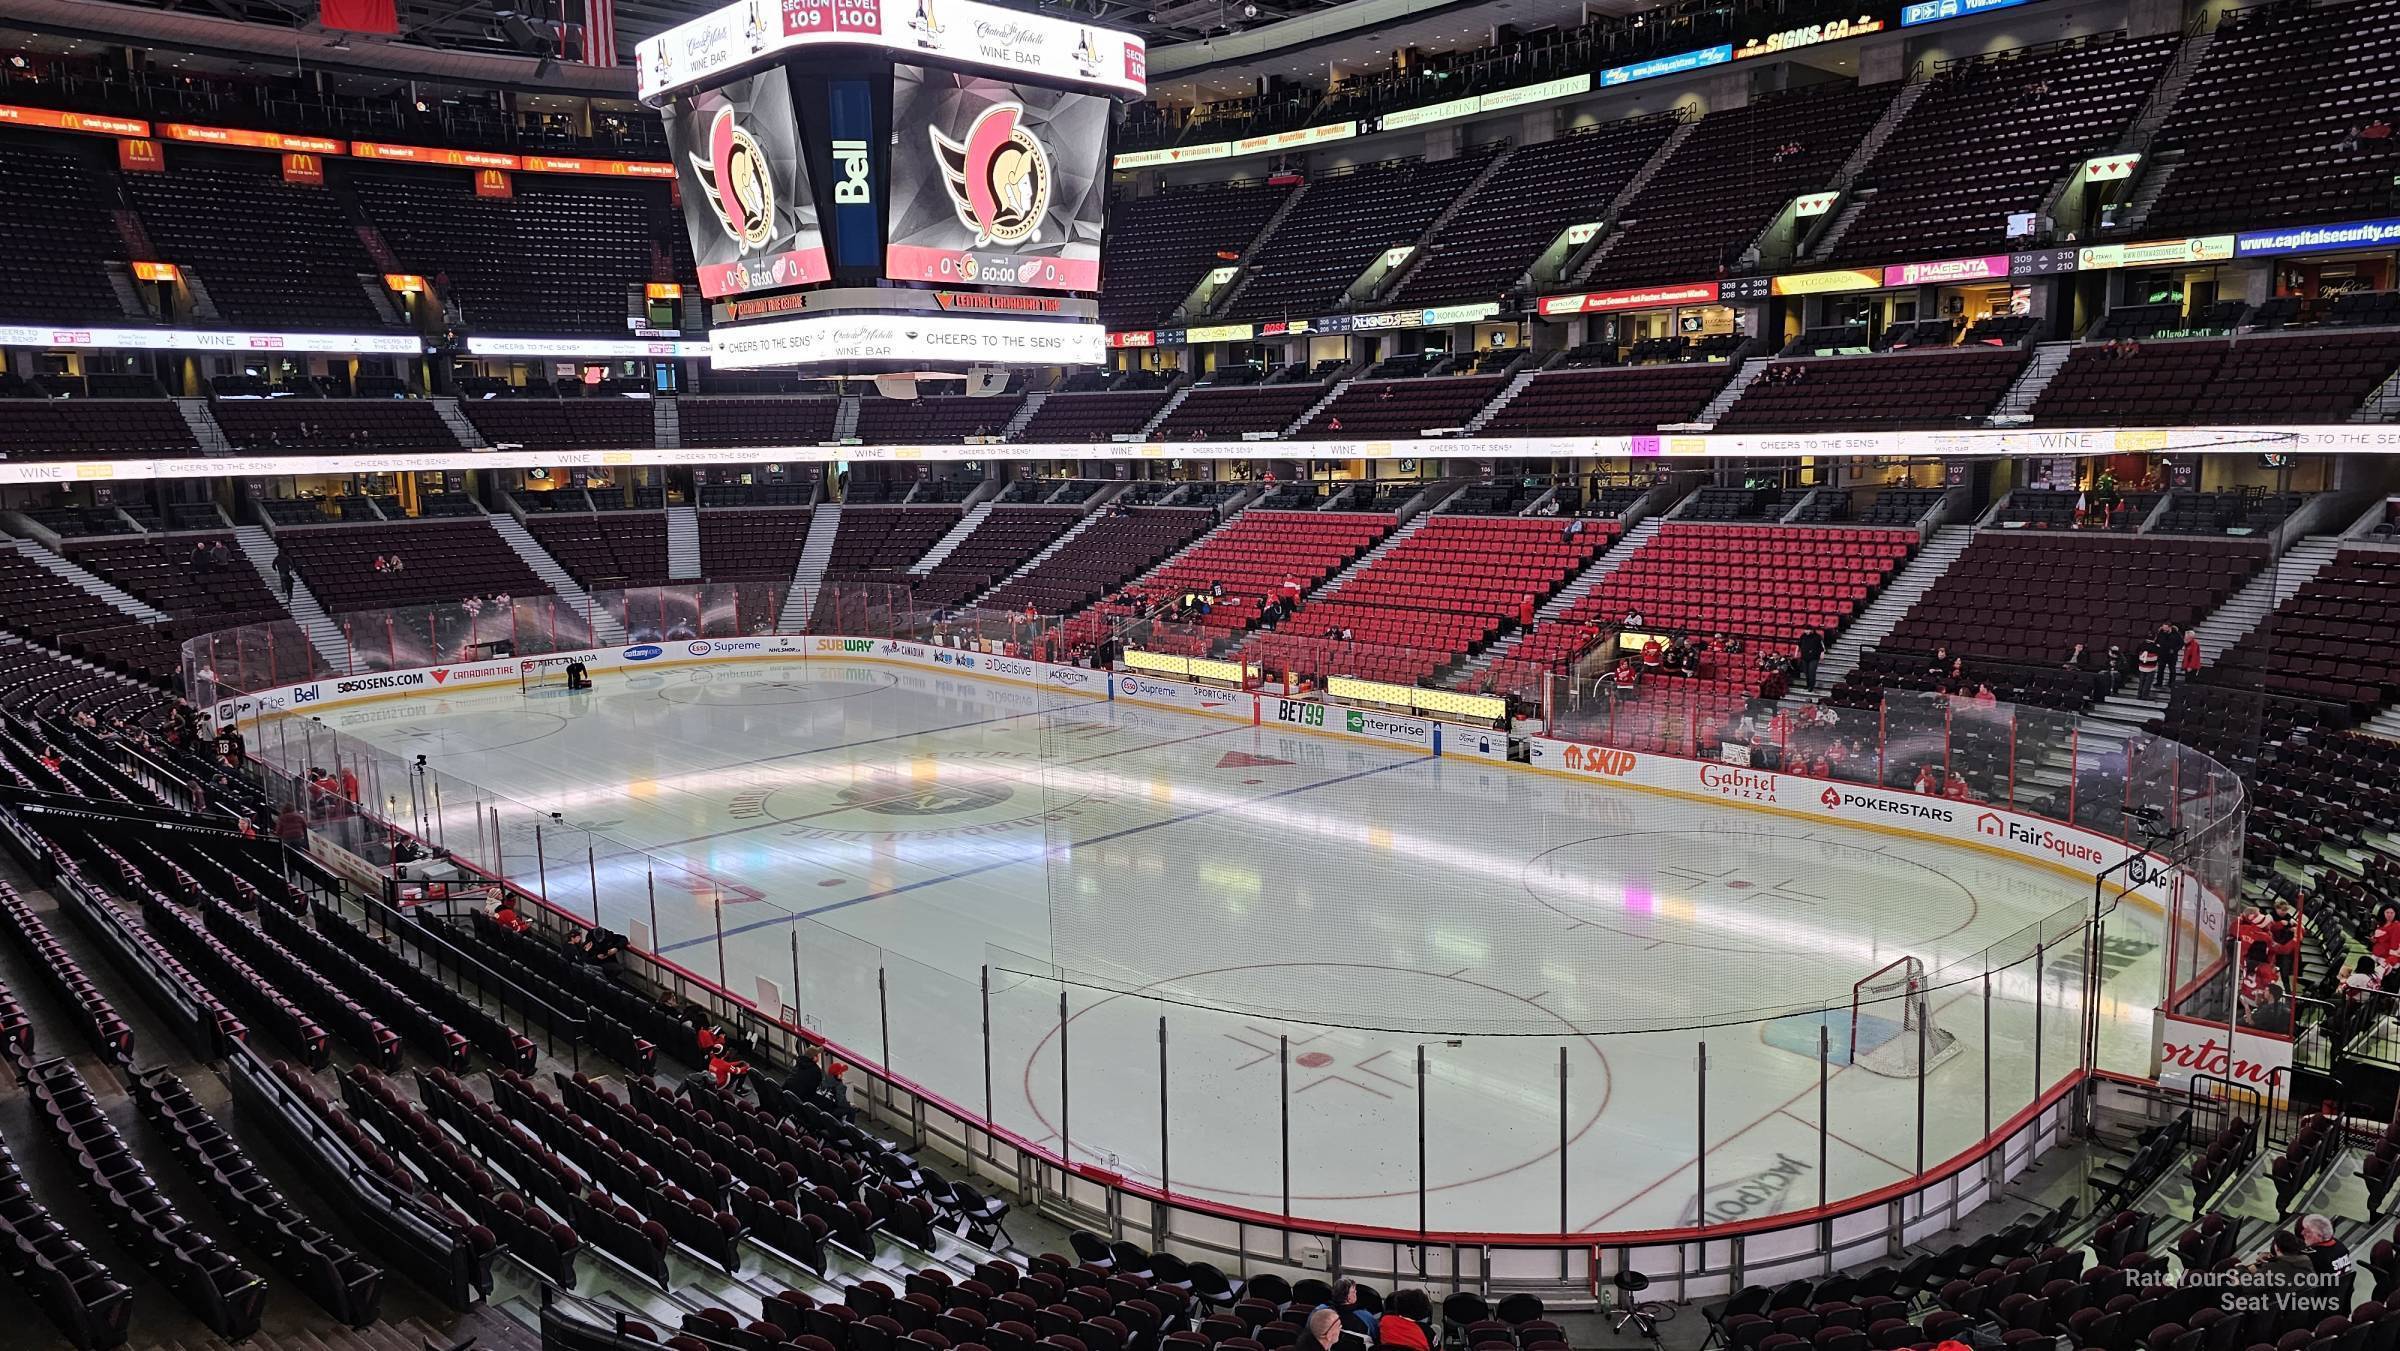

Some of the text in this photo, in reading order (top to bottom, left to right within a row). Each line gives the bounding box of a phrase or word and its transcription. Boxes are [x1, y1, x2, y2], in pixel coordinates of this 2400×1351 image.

[838, 0, 877, 10] LEVEL
[790, 10, 821, 28] 109
[840, 10, 877, 26] 100
[1766, 18, 1849, 52] SIGNS.CA
[690, 50, 728, 73] WINE BAR
[980, 44, 1041, 66] WINE BAR
[834, 140, 870, 204] Bell
[2240, 224, 2400, 250] www.capitalsecurity.ca
[2014, 254, 2032, 264] 309
[2057, 251, 2074, 260] 310
[940, 258, 951, 275] 0
[1046, 264, 1055, 281] 0
[1920, 259, 1988, 276] MAGENTA
[2013, 265, 2032, 274] 209
[2056, 262, 2074, 271] 210
[751, 270, 774, 288] 60:00
[982, 267, 1015, 282] 60:00
[1721, 282, 1736, 290] 308
[1753, 280, 1768, 288] 309
[1721, 291, 1736, 299] 208
[1753, 288, 1768, 297] 209
[1436, 311, 1466, 321] KONICA
[196, 335, 236, 346] WINE
[728, 338, 788, 354] CHEERS TO THE
[926, 333, 977, 346] CHEERS
[982, 335, 998, 346] TO
[1002, 336, 1025, 348] THE
[836, 346, 892, 356] WINE BAR
[1760, 440, 1842, 450] CHEERS TO THE
[2039, 434, 2093, 448] WINE
[2316, 434, 2334, 444] TO
[2340, 434, 2370, 444] THE
[2376, 434, 2400, 444] SE
[854, 448, 885, 458] WINE
[1110, 446, 1134, 456] WINE
[1330, 446, 1357, 455] WINE
[1429, 444, 1486, 452] CHEERS TO THE
[1620, 440, 1658, 453] WINE
[558, 454, 591, 464] WINE
[19, 467, 63, 479] WINE
[170, 463, 208, 472] CHEERS
[210, 463, 224, 471] TO
[2174, 466, 2192, 474] 108
[714, 641, 761, 653] Supreme
[816, 639, 872, 653] SUBWAY
[453, 666, 514, 680] CANADIAN TIRE
[994, 658, 1032, 677] Decisive
[294, 684, 319, 704] Bell
[1140, 682, 1176, 698] Supreme
[1278, 699, 1325, 727] BET99
[1350, 714, 1425, 737] enterprise
[1458, 733, 1476, 744] Ford
[218, 743, 229, 754] 18
[1584, 746, 1637, 776] SKIP
[1700, 764, 1776, 792] Gabriel
[1722, 786, 1777, 803] PIZZA
[1844, 793, 1953, 824] POKERSTARS
[2009, 822, 2102, 865] FairSquare
